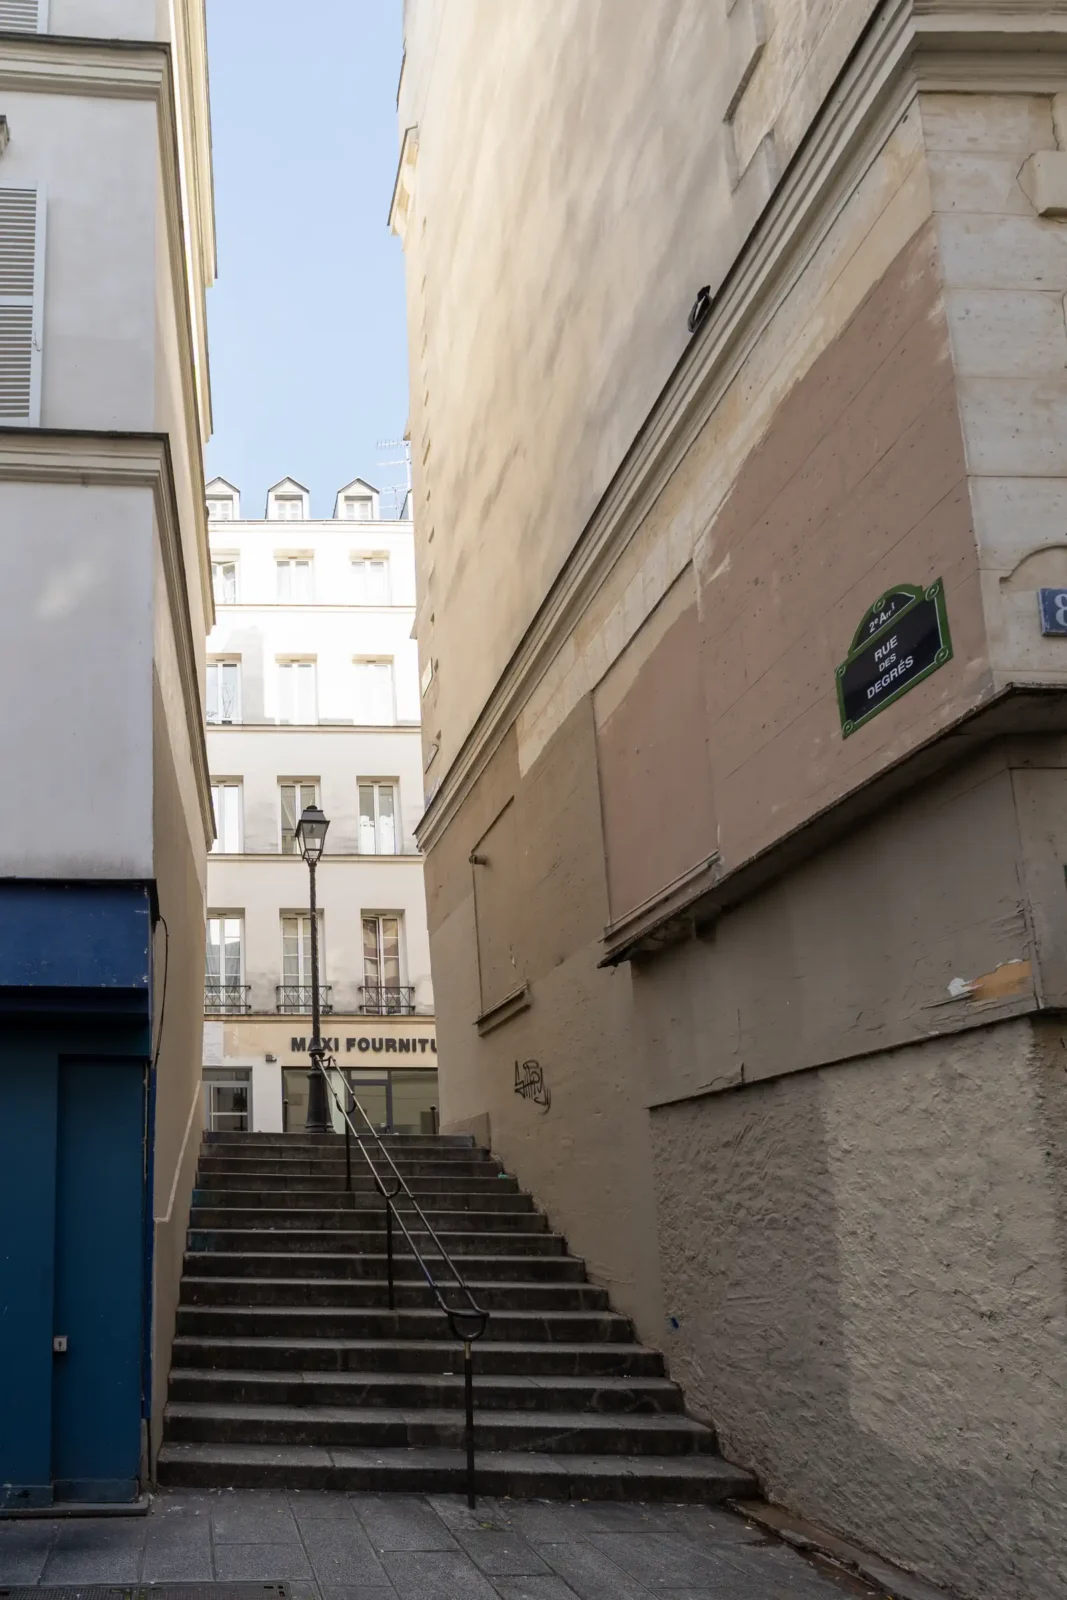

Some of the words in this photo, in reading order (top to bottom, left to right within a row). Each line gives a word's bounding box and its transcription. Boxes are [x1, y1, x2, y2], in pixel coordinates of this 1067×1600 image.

[1054, 593, 1067, 627] 8
[874, 635, 899, 662] RUE
[879, 653, 897, 672] DES
[867, 655, 914, 699] DEGRÉS
